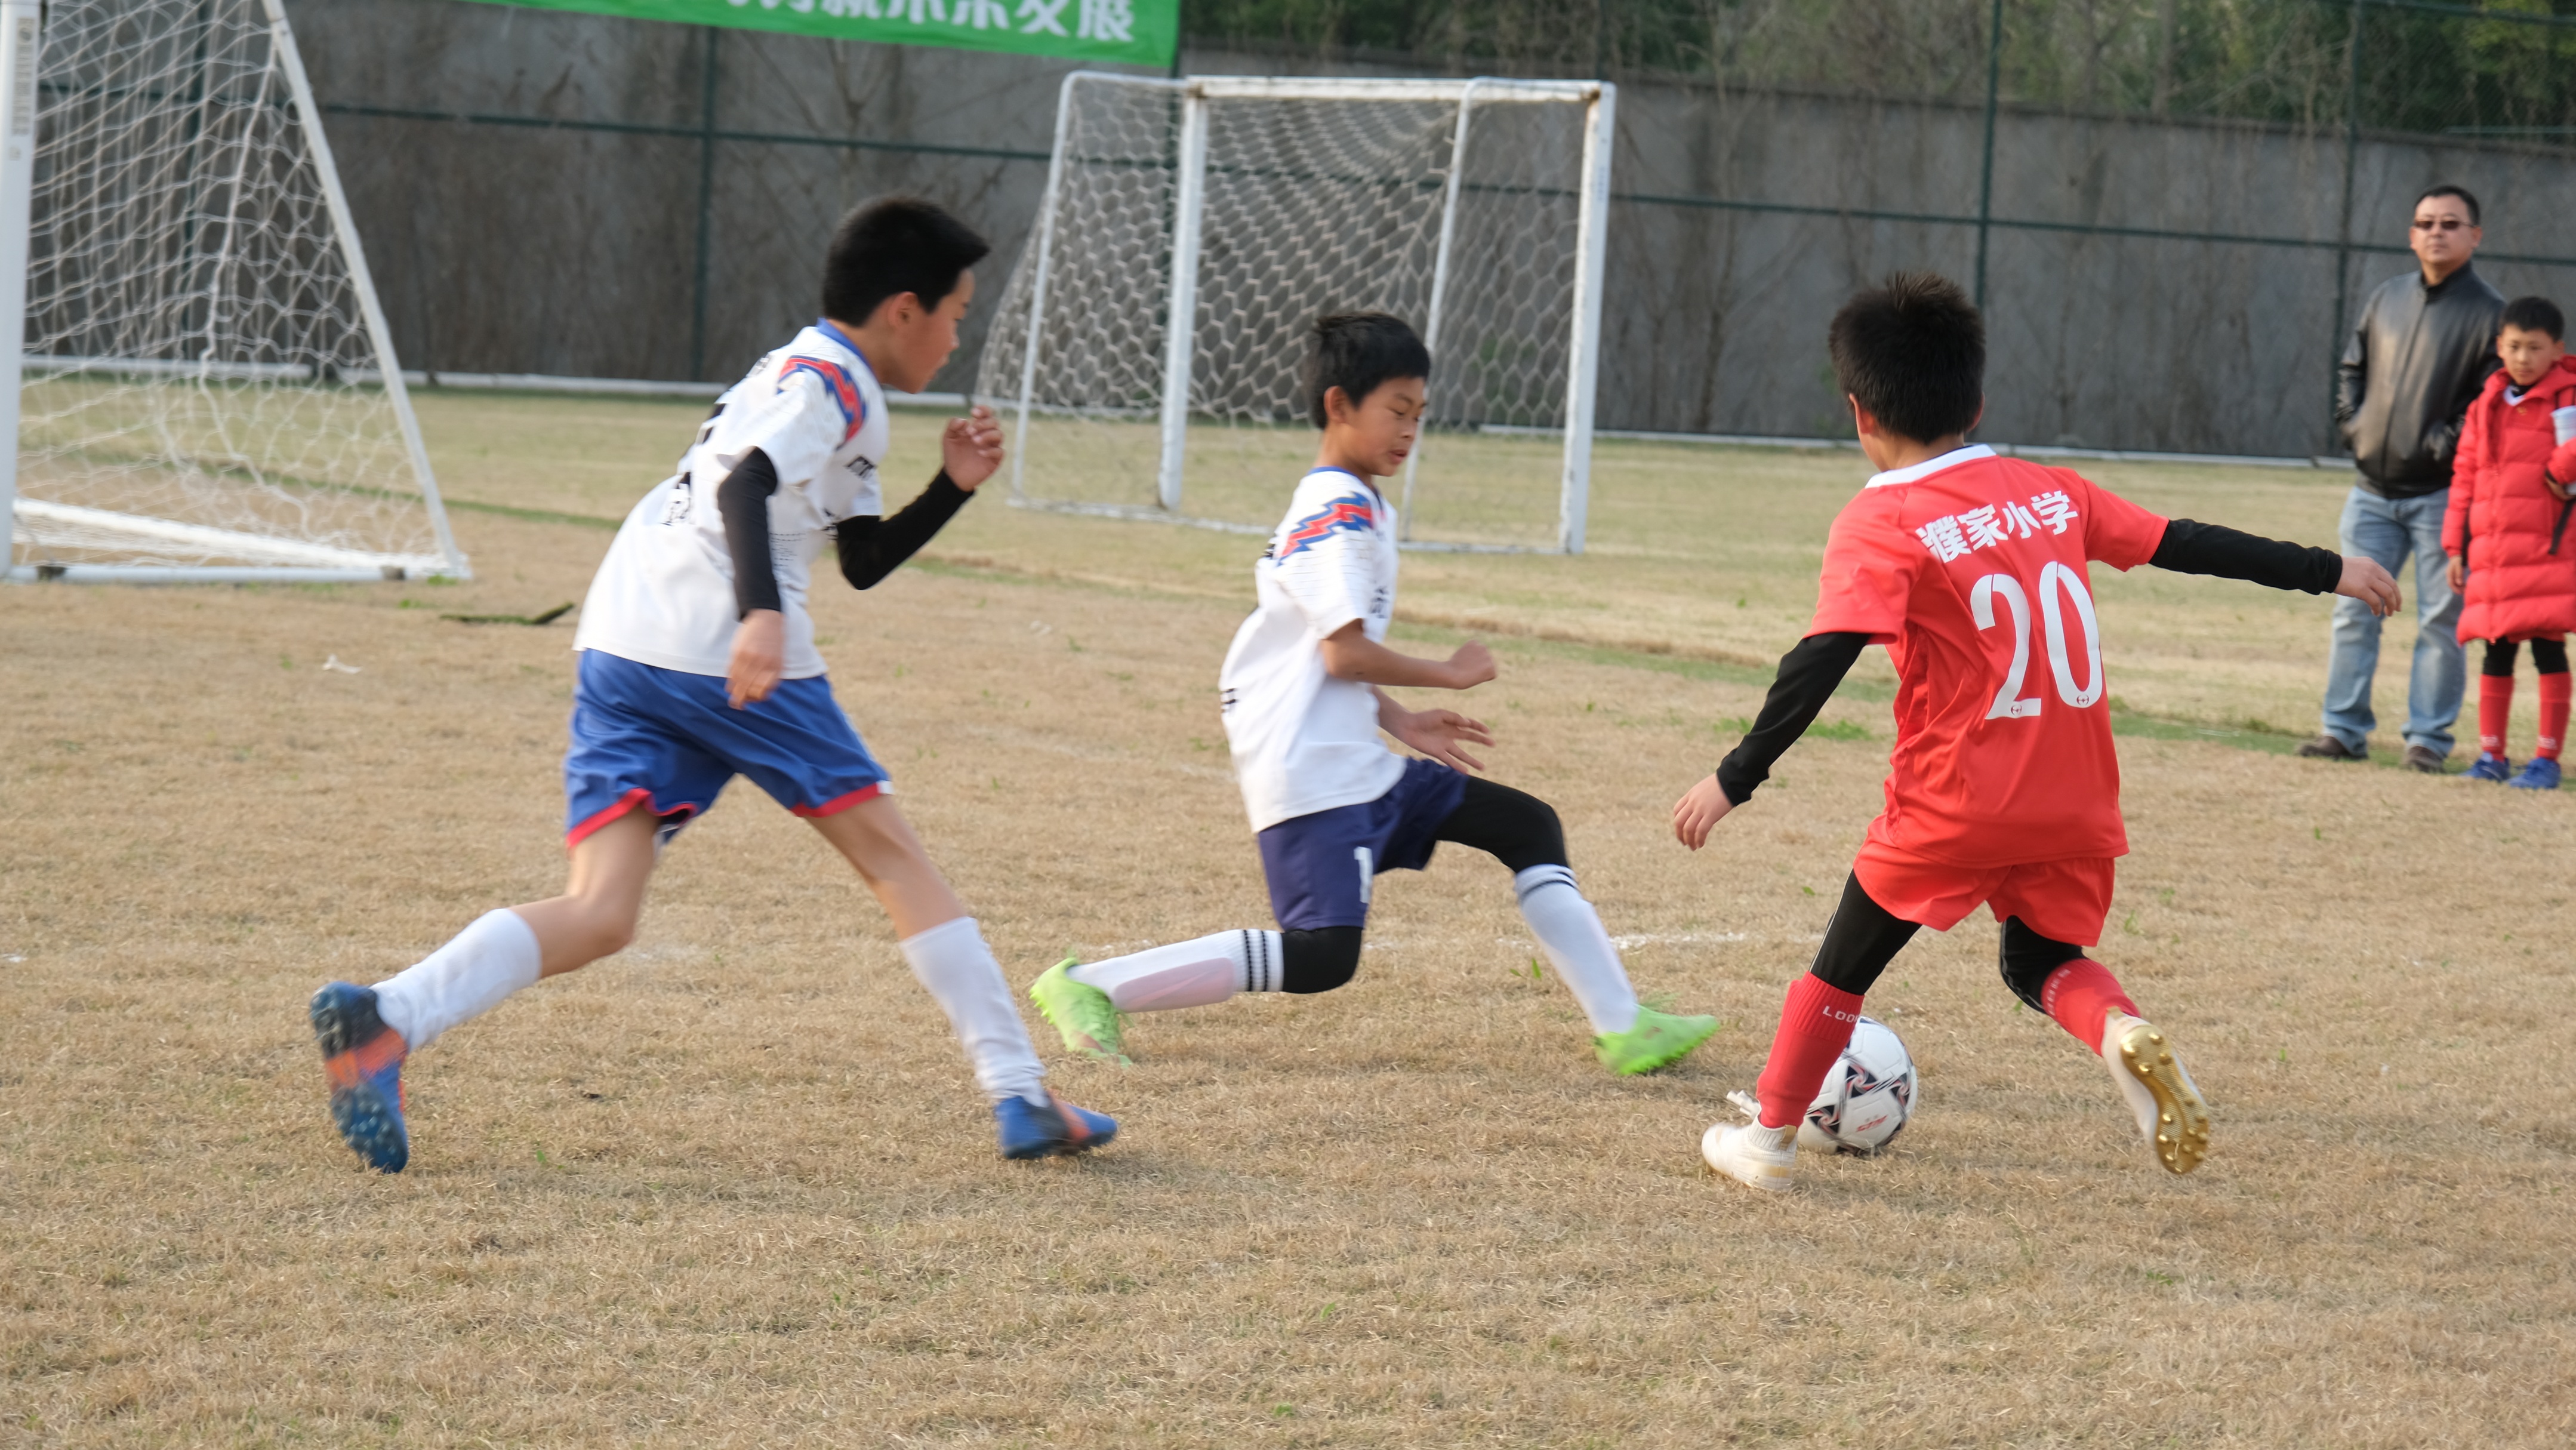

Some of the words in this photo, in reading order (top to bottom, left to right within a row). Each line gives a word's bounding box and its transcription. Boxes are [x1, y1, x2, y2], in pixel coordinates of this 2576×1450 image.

[1915, 490, 2078, 564] 濮家小学
[1970, 561, 2103, 720] 20
